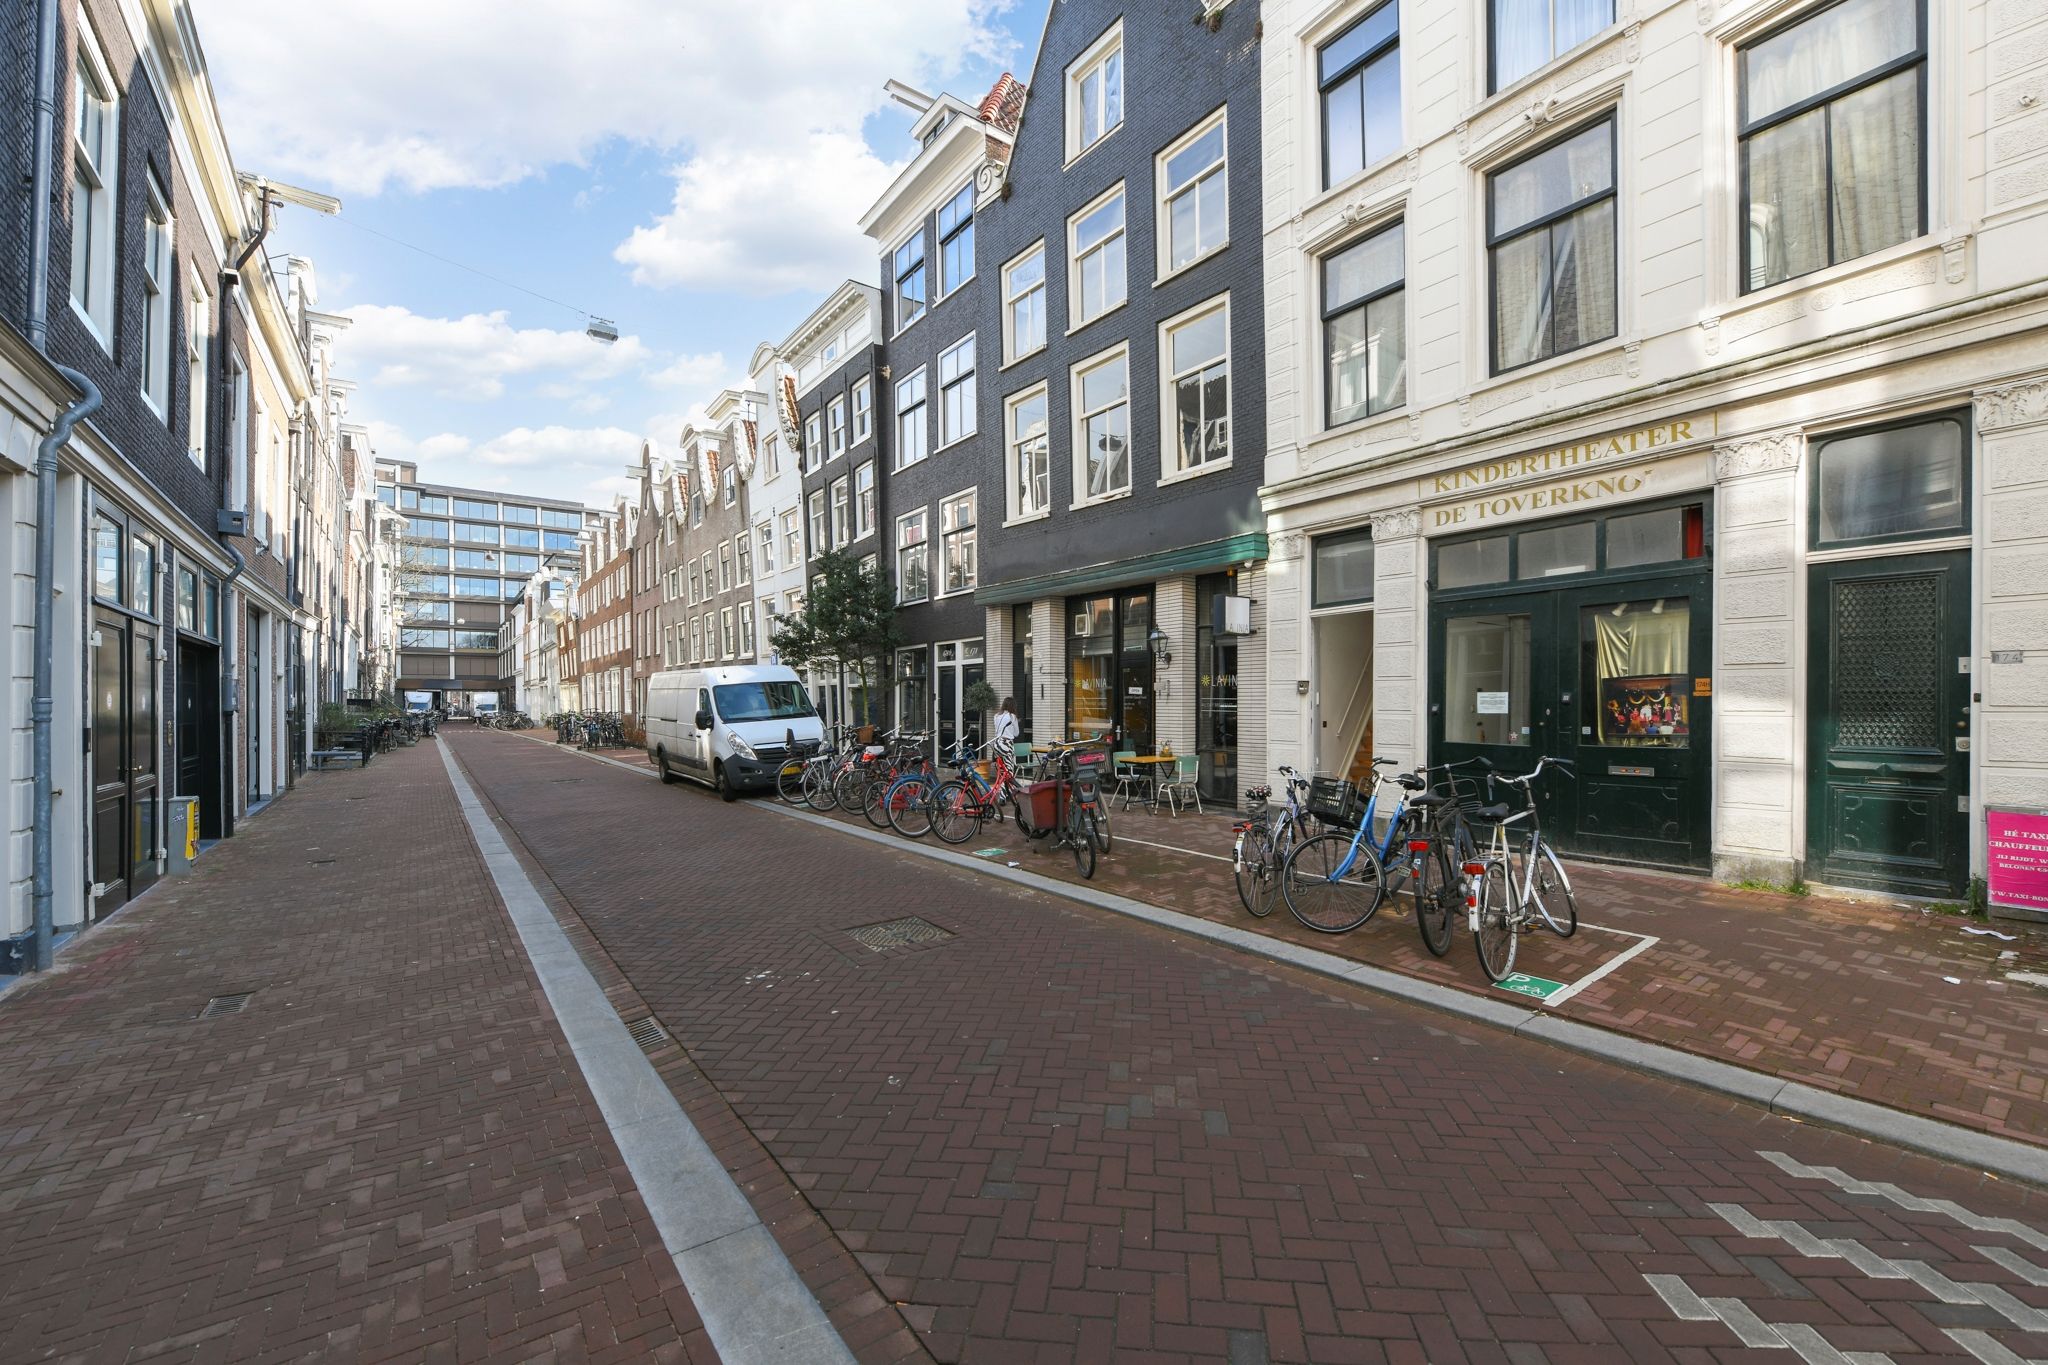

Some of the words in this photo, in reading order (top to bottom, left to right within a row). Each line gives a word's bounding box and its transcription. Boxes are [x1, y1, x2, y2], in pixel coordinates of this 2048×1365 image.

[1435, 421, 1693, 493] KINDERTHEATER
[1435, 507, 1466, 527] DE
[1475, 469, 1652, 519] TOVERKNO
[2004, 829, 2018, 837] HÉ
[1999, 862, 2035, 871] BELONEN
